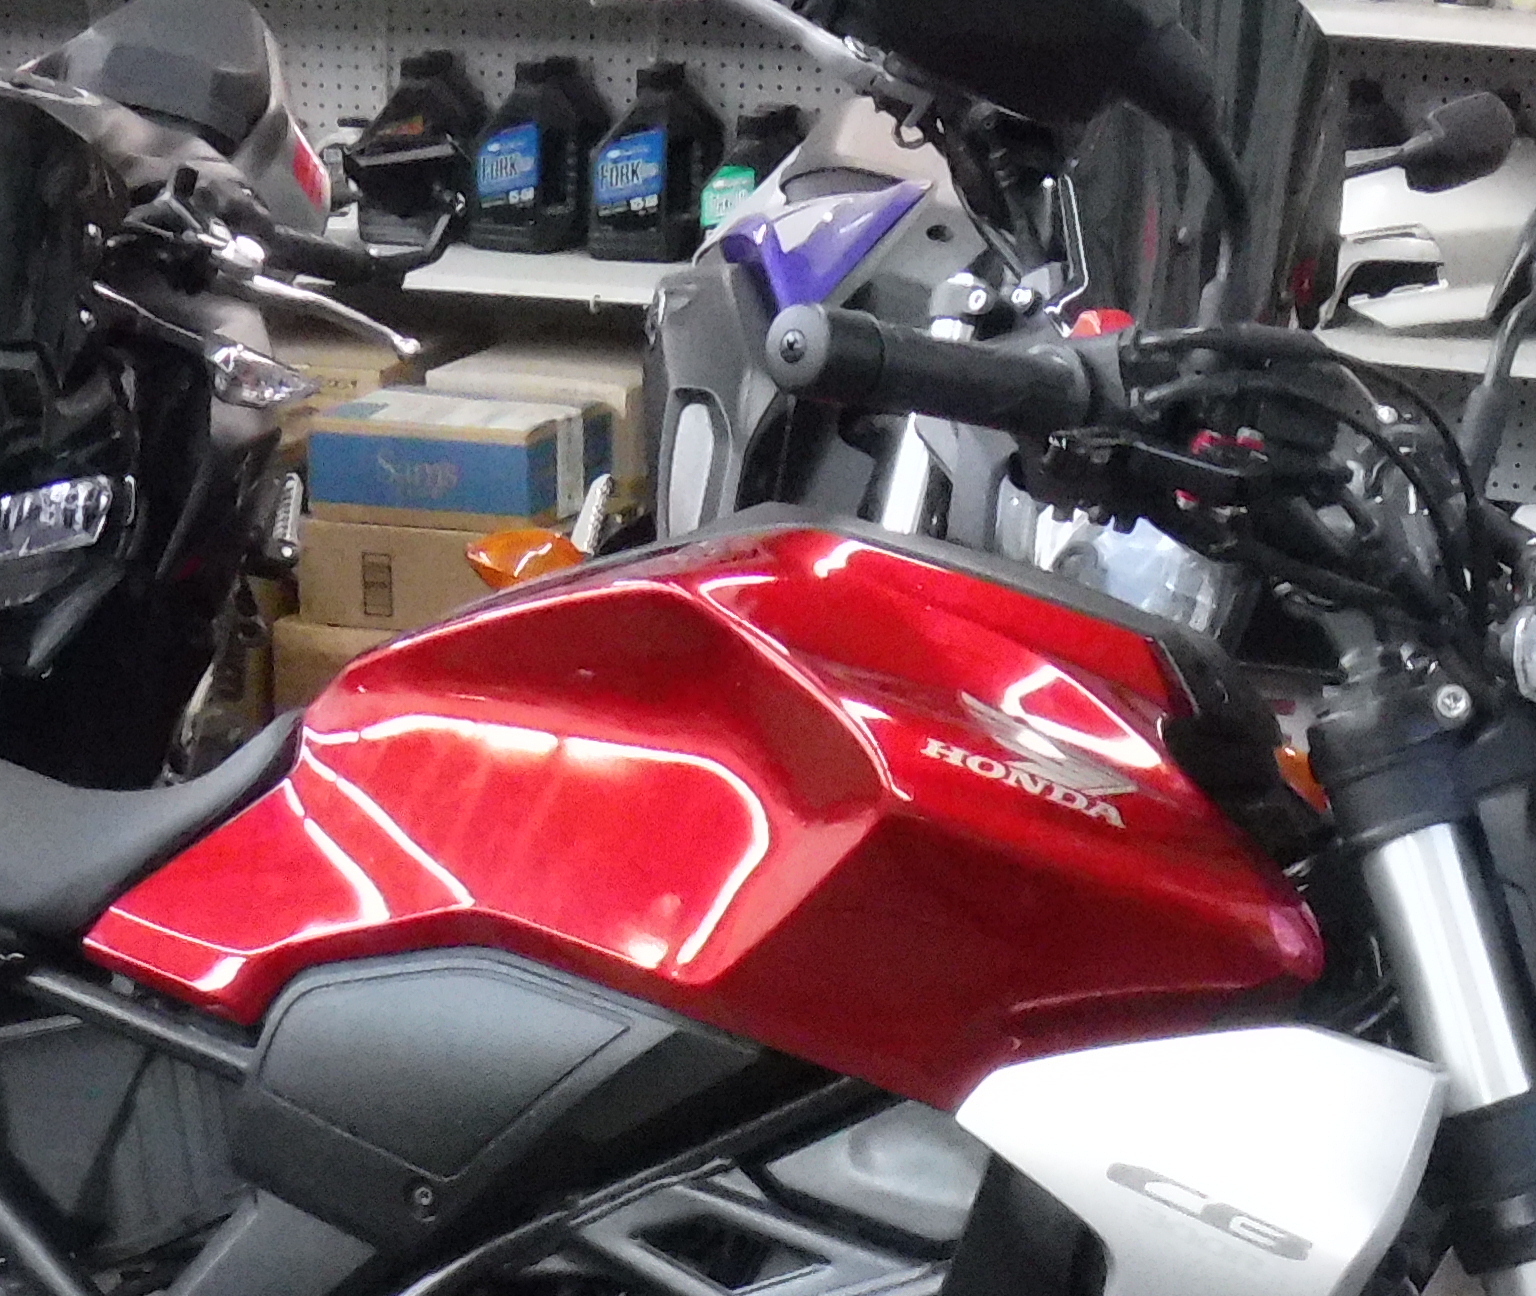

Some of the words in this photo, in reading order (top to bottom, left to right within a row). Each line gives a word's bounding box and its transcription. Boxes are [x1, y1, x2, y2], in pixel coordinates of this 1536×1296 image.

[480, 153, 520, 184] FORK
[598, 158, 643, 191] FORK
[920, 737, 1127, 829] HONDA
